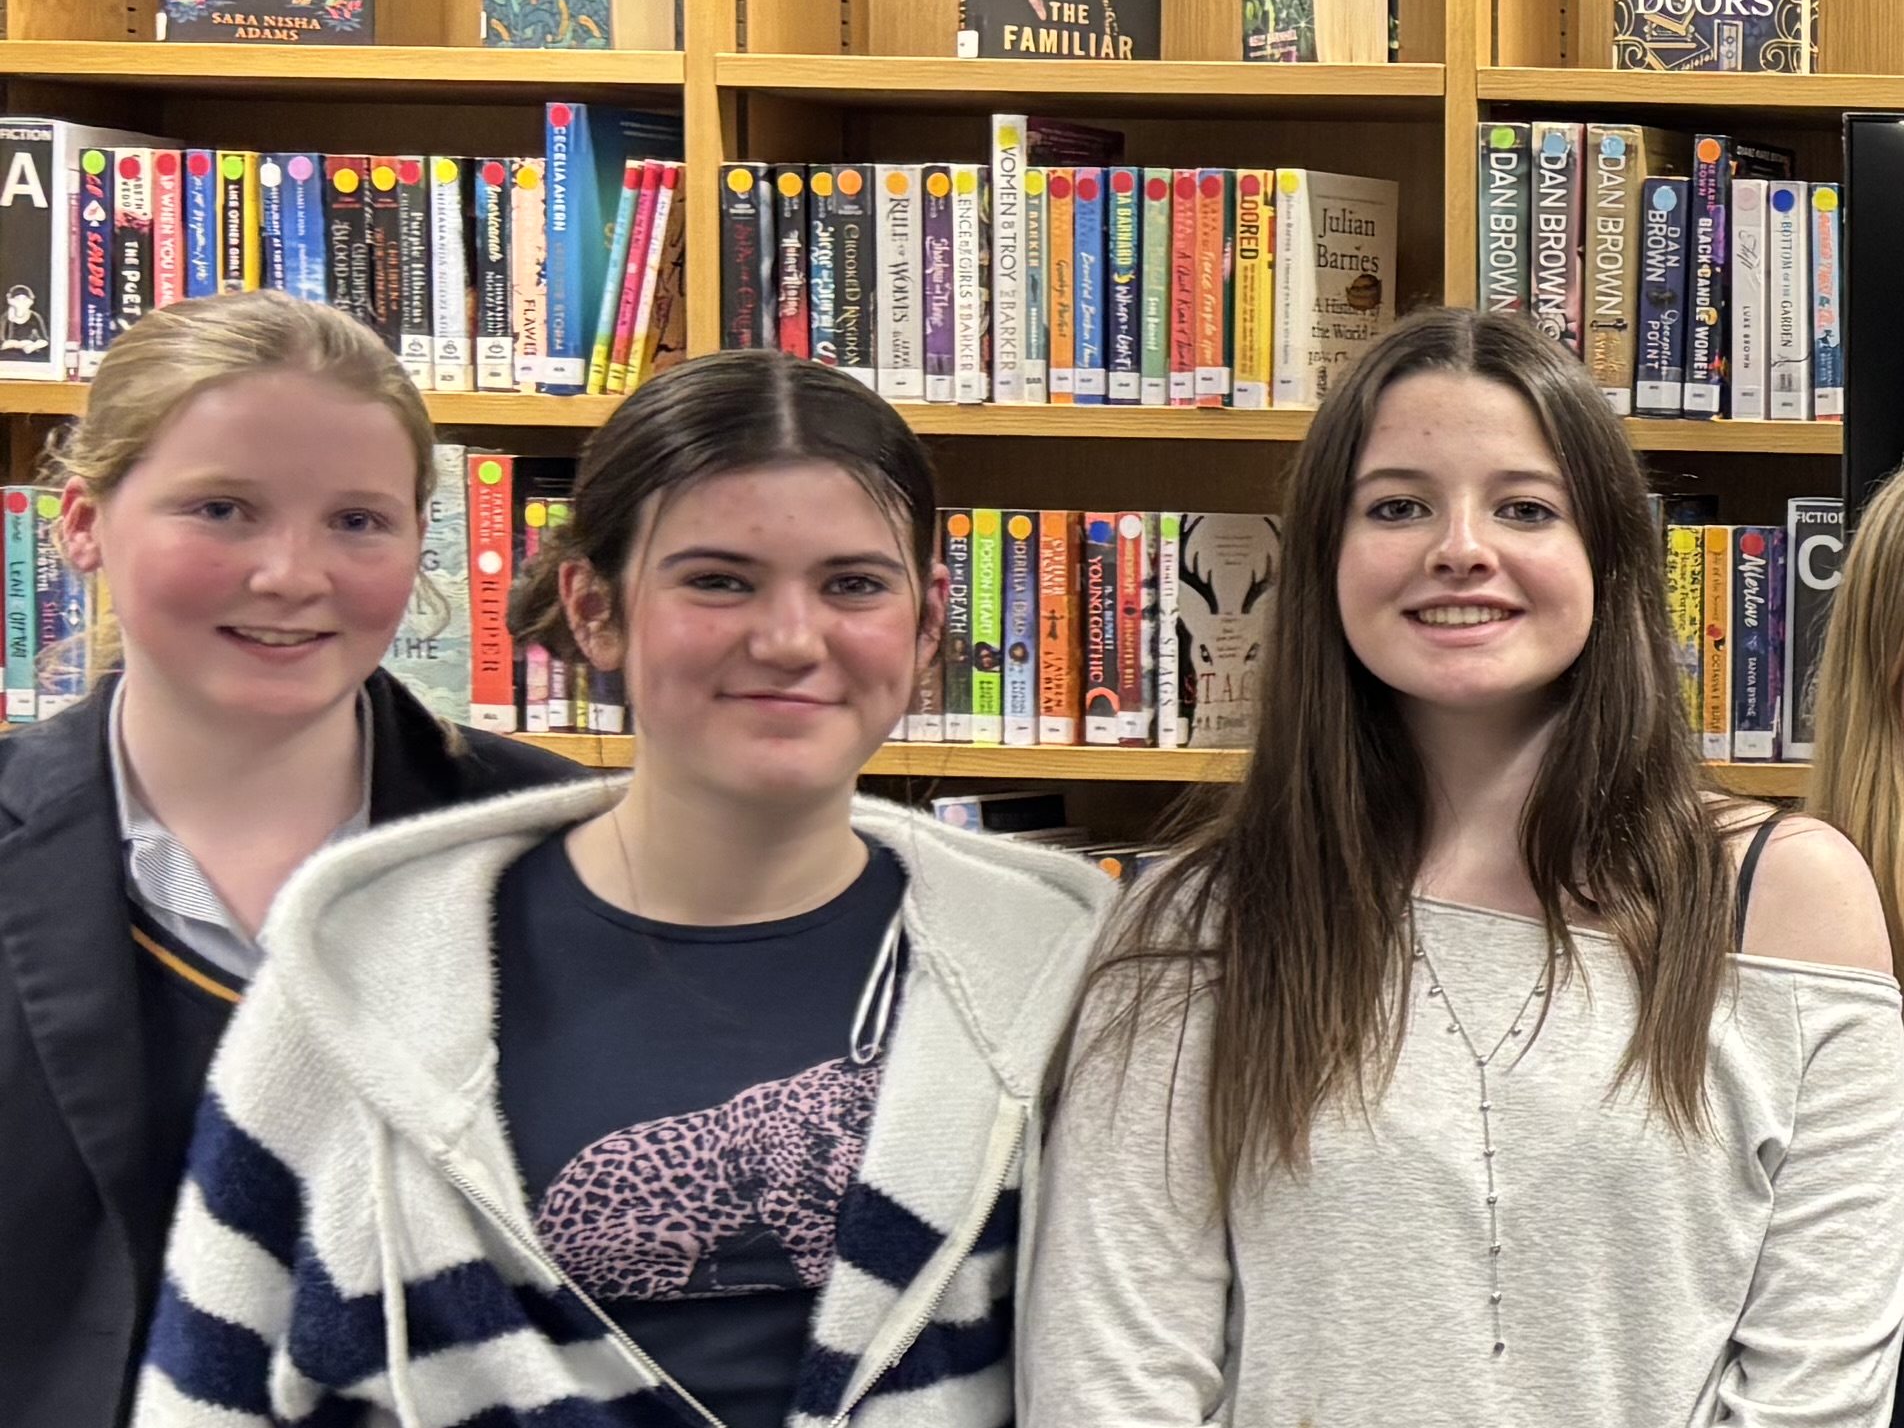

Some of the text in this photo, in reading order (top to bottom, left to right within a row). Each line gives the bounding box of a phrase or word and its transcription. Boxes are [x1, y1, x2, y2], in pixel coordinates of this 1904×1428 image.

[212, 12, 322, 30] SARA NISHA
[236, 27, 299, 41] ADAMS
[1049, 1, 1090, 24] THE
[1004, 24, 1133, 60] FAMILIAR
[0, 152, 49, 208] A
[552, 126, 566, 182] CECELIA
[1597, 153, 1626, 209] DAN
[228, 184, 240, 207] LIKE
[485, 184, 503, 262] Americanah
[552, 184, 567, 231] AHERN
[887, 197, 910, 242] RULE
[1318, 207, 1376, 238] Julian
[124, 241, 139, 265] THE
[161, 194, 175, 269] WHEN YOU
[228, 210, 240, 245] OTHER
[1029, 211, 1038, 267] BARKER
[1488, 153, 1518, 313] DAN BROWN
[1538, 152, 1567, 314] DAN BROWN
[1646, 210, 1667, 282] BROWN
[1667, 226, 1680, 267] DAN
[409, 212, 425, 324] Purple Hibiscus
[843, 224, 861, 301] CROOKED
[1115, 208, 1135, 322] BARNARD Where
[1202, 250, 1215, 290] Fierce
[1316, 243, 1380, 273] Barnes
[1595, 216, 1624, 315] BROWN
[1781, 221, 1793, 348] BOTTOM GARDEN
[888, 262, 915, 322] WOLVES
[959, 257, 974, 372] GIRLS BARKER
[999, 233, 1017, 371] TROY BARKER
[1693, 218, 1712, 379] BLACK CANDLE WOMEN
[1647, 320, 1659, 369] POINT
[1659, 309, 1679, 376] Deception
[480, 488, 491, 545] ALLENDE
[493, 492, 505, 537] ISABEL
[980, 538, 995, 636] POISON HEART
[1798, 535, 1844, 590] C
[481, 580, 500, 672] RIPPER
[950, 584, 967, 634] DEATH
[1088, 555, 1103, 683] YOUNG GOTHIC
[1679, 592, 1688, 631] Fortune
[1738, 554, 1767, 717] Afterlove TANYA BYRNE
